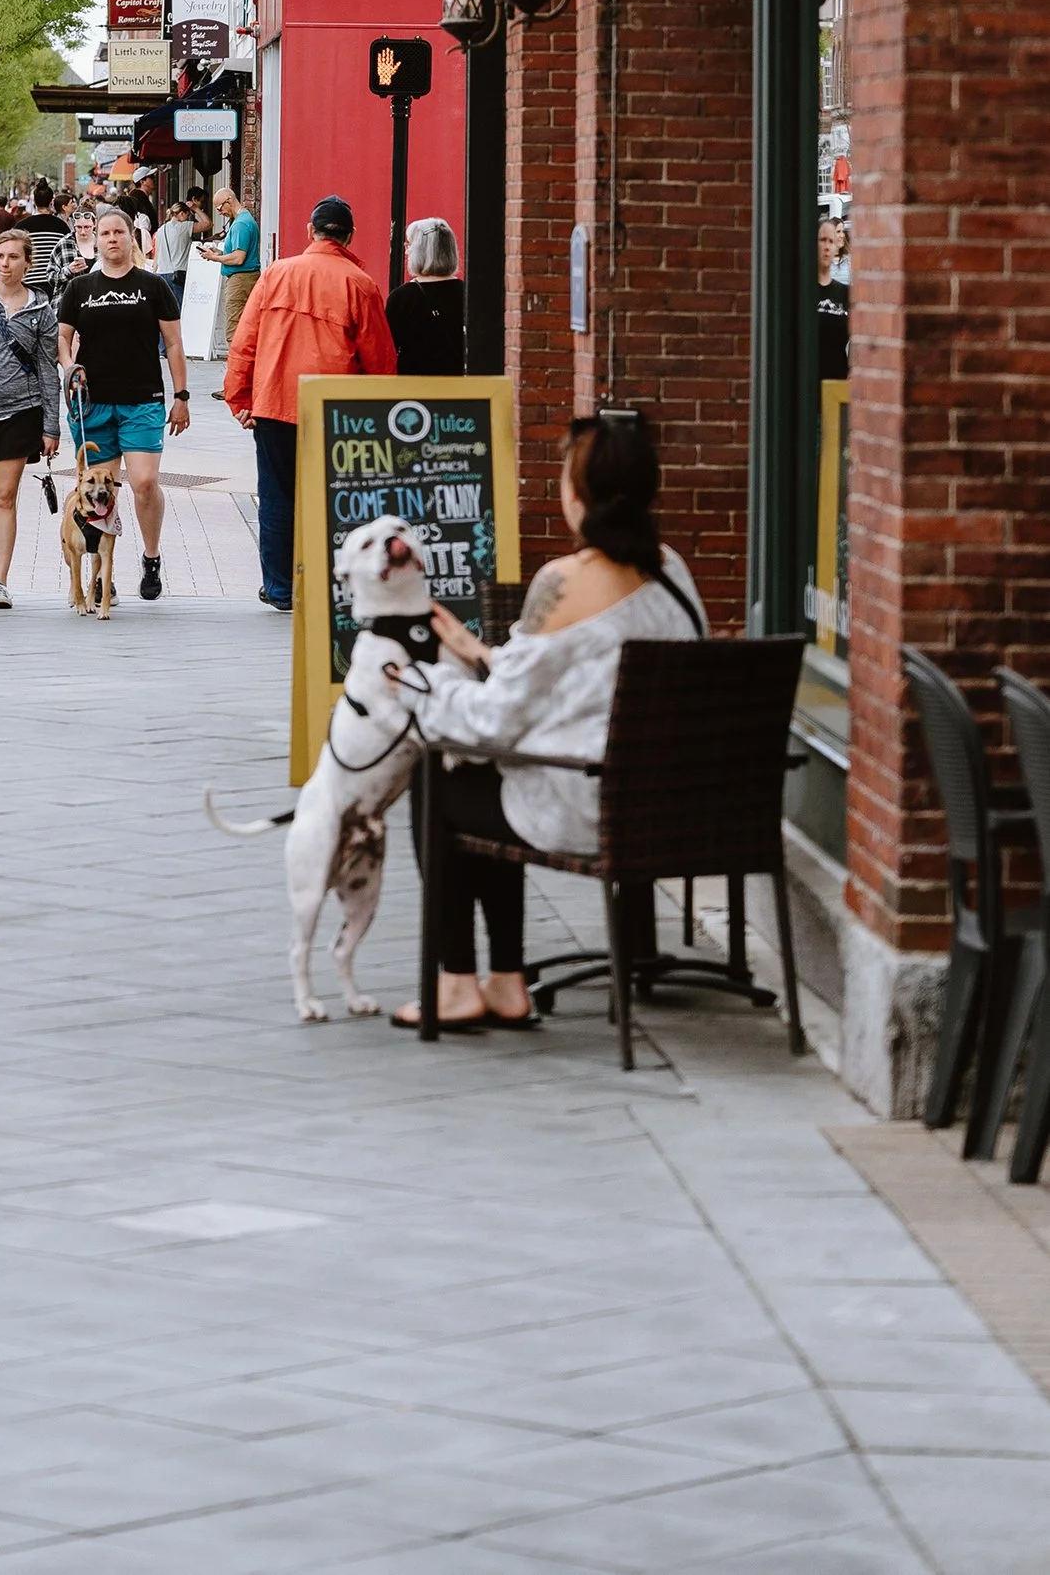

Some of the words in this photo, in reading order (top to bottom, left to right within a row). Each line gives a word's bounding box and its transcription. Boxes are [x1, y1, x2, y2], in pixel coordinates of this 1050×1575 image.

[186, 0, 226, 14] Jewelry
[191, 32, 205, 40] Gold
[114, 47, 137, 56] Little
[140, 48, 164, 56] River
[111, 75, 144, 86] Oriental
[147, 76, 167, 88] Rugs
[180, 122, 232, 133] dandelion
[332, 409, 377, 435] live
[429, 412, 476, 443] juice
[331, 438, 394, 474] OPEN
[393, 486, 425, 520] IN
[433, 483, 481, 519] ENJOY
